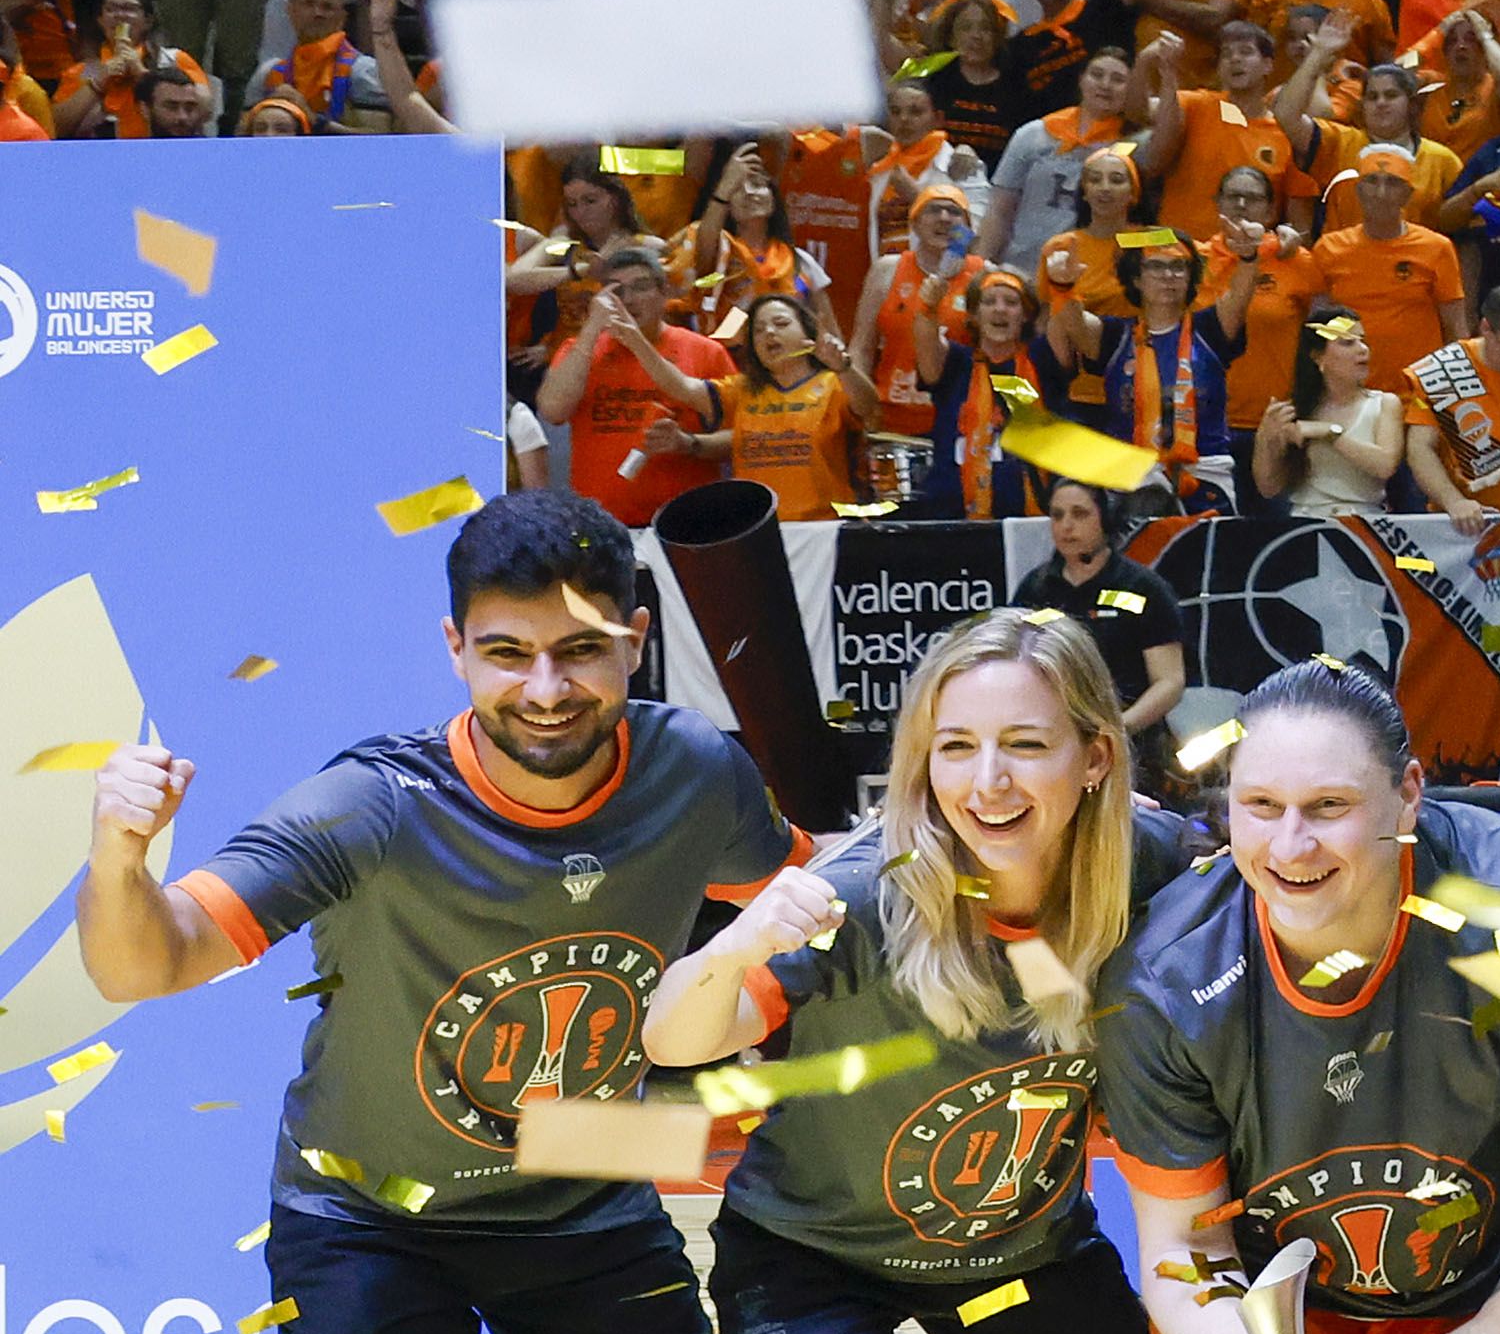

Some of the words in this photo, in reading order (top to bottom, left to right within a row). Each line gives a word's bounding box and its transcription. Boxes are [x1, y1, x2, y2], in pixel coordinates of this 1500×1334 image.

[45, 291, 154, 311] UNIVERSO
[47, 312, 154, 337] MUJER
[835, 573, 994, 616] valencia
